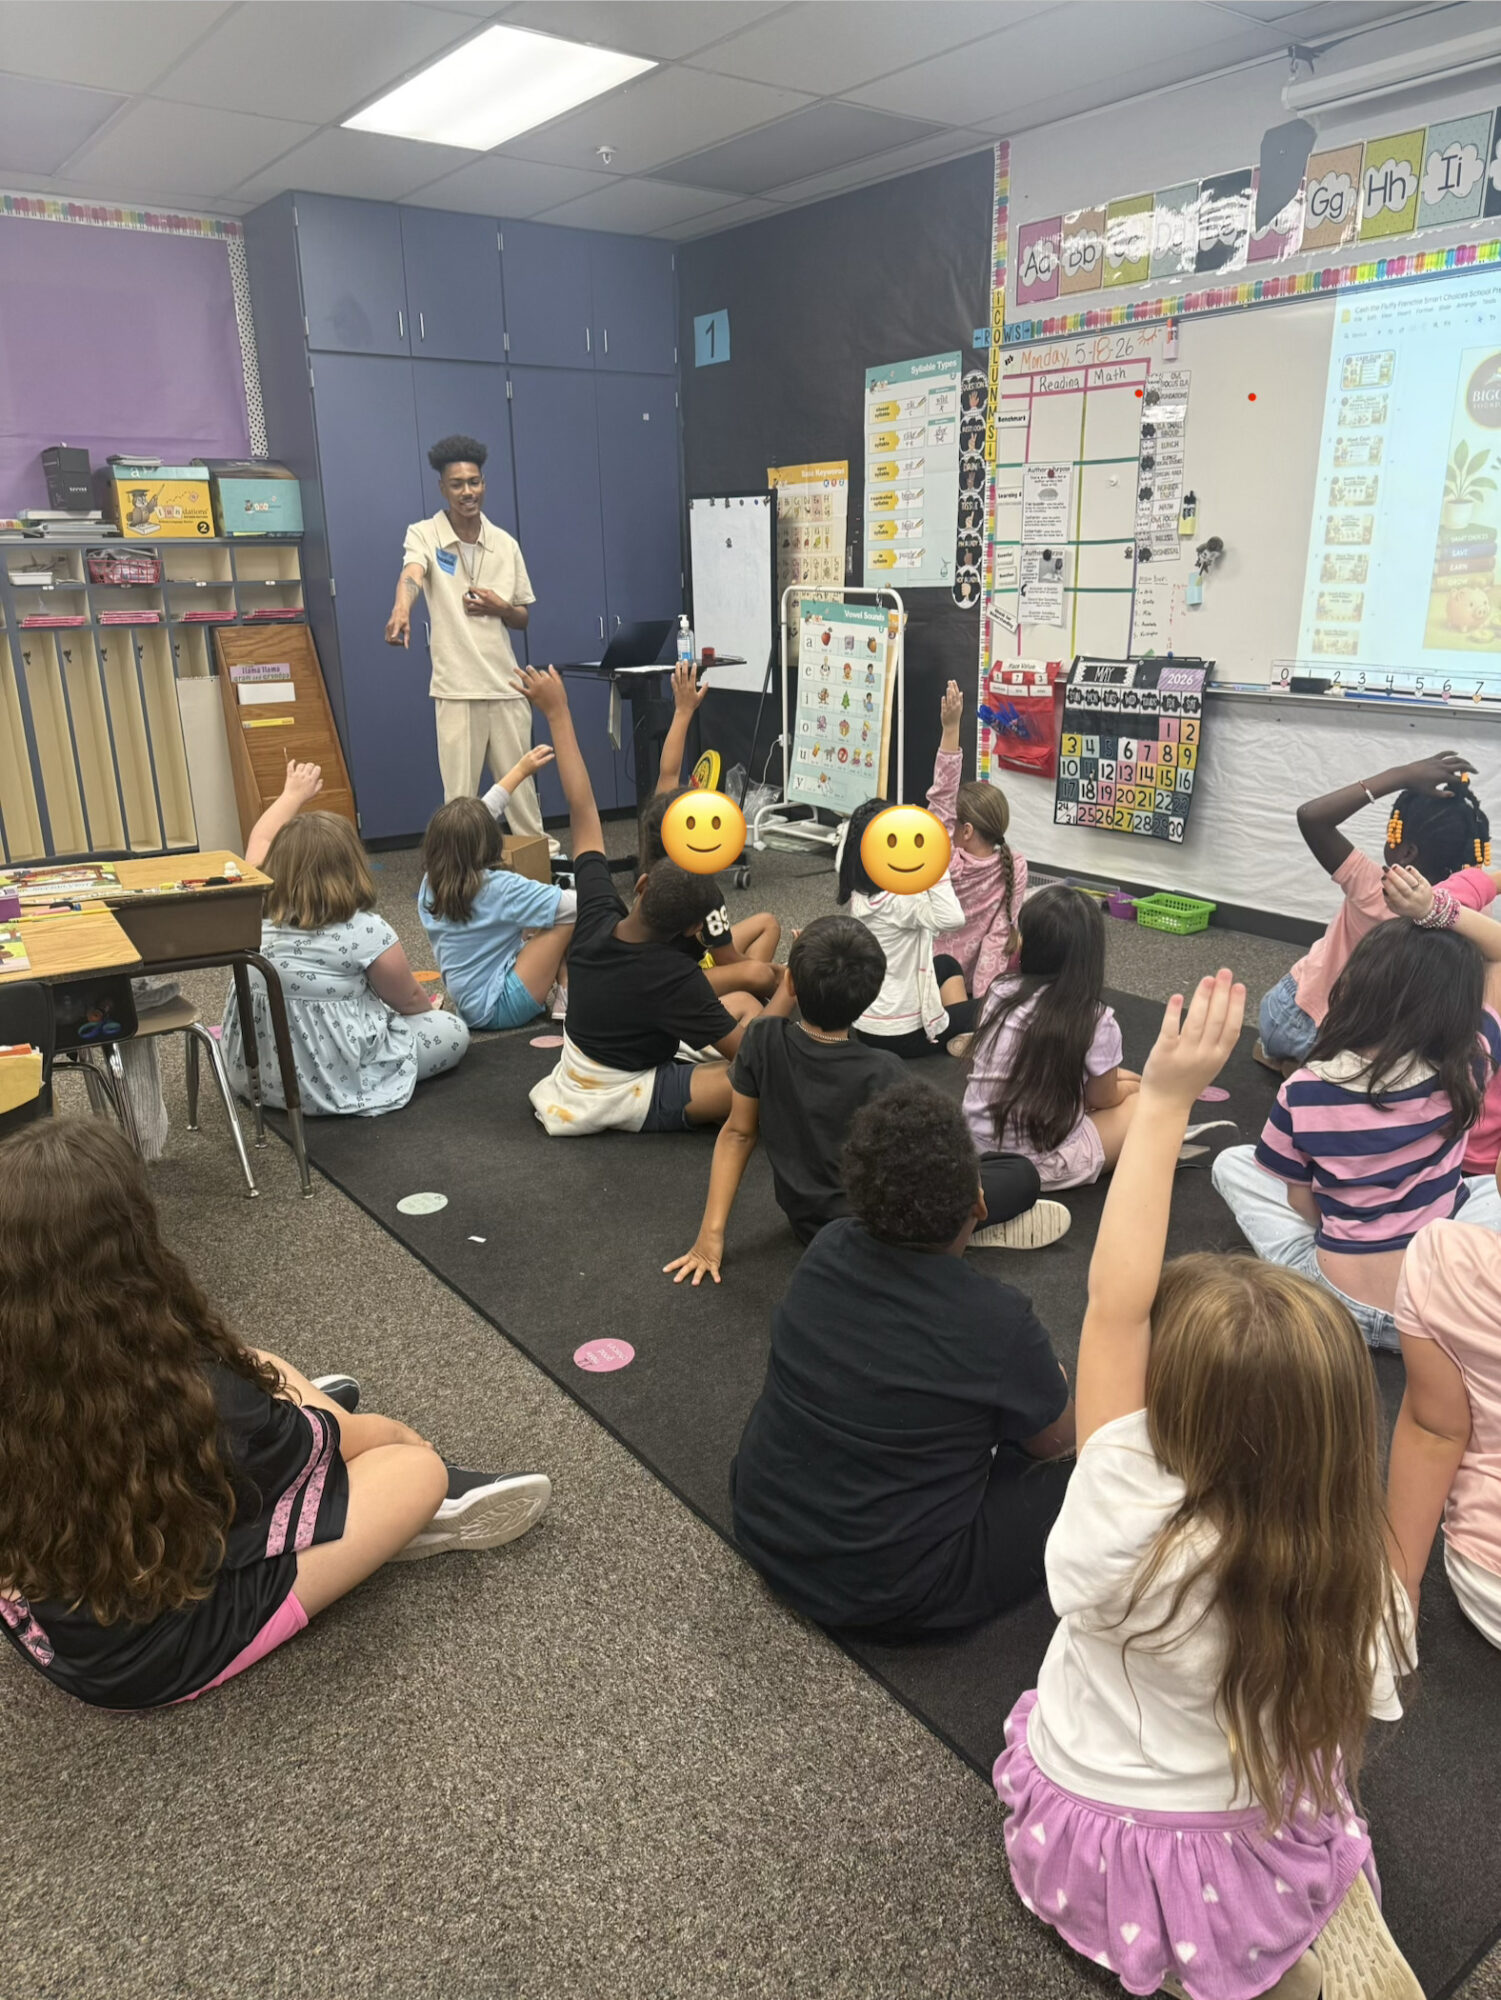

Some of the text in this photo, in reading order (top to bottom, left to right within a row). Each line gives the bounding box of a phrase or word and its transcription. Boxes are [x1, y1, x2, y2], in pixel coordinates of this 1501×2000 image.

[1024, 251, 1051, 278] Aa
[1310, 186, 1343, 219] Gg
[1366, 170, 1406, 206] Hh
[1437, 154, 1461, 191] Ii
[1443, 291, 1468, 302] Choices
[1469, 288, 1491, 298] School
[705, 319, 716, 359] 1
[1021, 336, 1134, 374] Monday, 5-18-26
[911, 359, 958, 376] Syllable Types
[1094, 367, 1126, 384] Math
[1039, 374, 1080, 393] Reading
[200, 522, 207, 532] 2
[1449, 563, 1468, 572] EARN
[844, 608, 863, 619] Vowel
[863, 610, 885, 622] Sounds
[806, 636, 813, 647] a
[805, 666, 811, 676] e
[1095, 668, 1113, 682] MAY
[1167, 674, 1193, 685] 2026
[1279, 668, 1288, 680] 0
[1332, 671, 1341, 683] 2
[1357, 672, 1365, 685] 3
[1385, 674, 1393, 688] 4
[1415, 677, 1424, 690] 5
[1442, 679, 1452, 692] 6
[1475, 681, 1484, 695] 7
[1069, 692, 1080, 701] SUN
[1087, 693, 1098, 702] MON
[1186, 701, 1195, 710] SAT
[802, 723, 809, 731] o
[1187, 723, 1194, 741] 2
[800, 750, 807, 760] u
[1067, 737, 1076, 752] 3
[1086, 739, 1094, 754] 4
[1124, 741, 1132, 759] 6
[1144, 746, 1151, 761] 7
[1163, 745, 1172, 762] 8
[1184, 748, 1191, 764] 9
[795, 777, 804, 789] y
[1062, 760, 1077, 774] 10
[1101, 764, 1113, 780] 12
[1119, 765, 1133, 781] 13
[1140, 765, 1154, 782] 14
[1160, 769, 1172, 787] 15
[1179, 774, 1190, 793] 16
[1058, 802, 1069, 810] 24
[1063, 782, 1188, 815] 17 18 19 20 21 22 23
[1066, 815, 1076, 823] 31
[1079, 808, 1182, 837] 25 26 27 28 29 30
